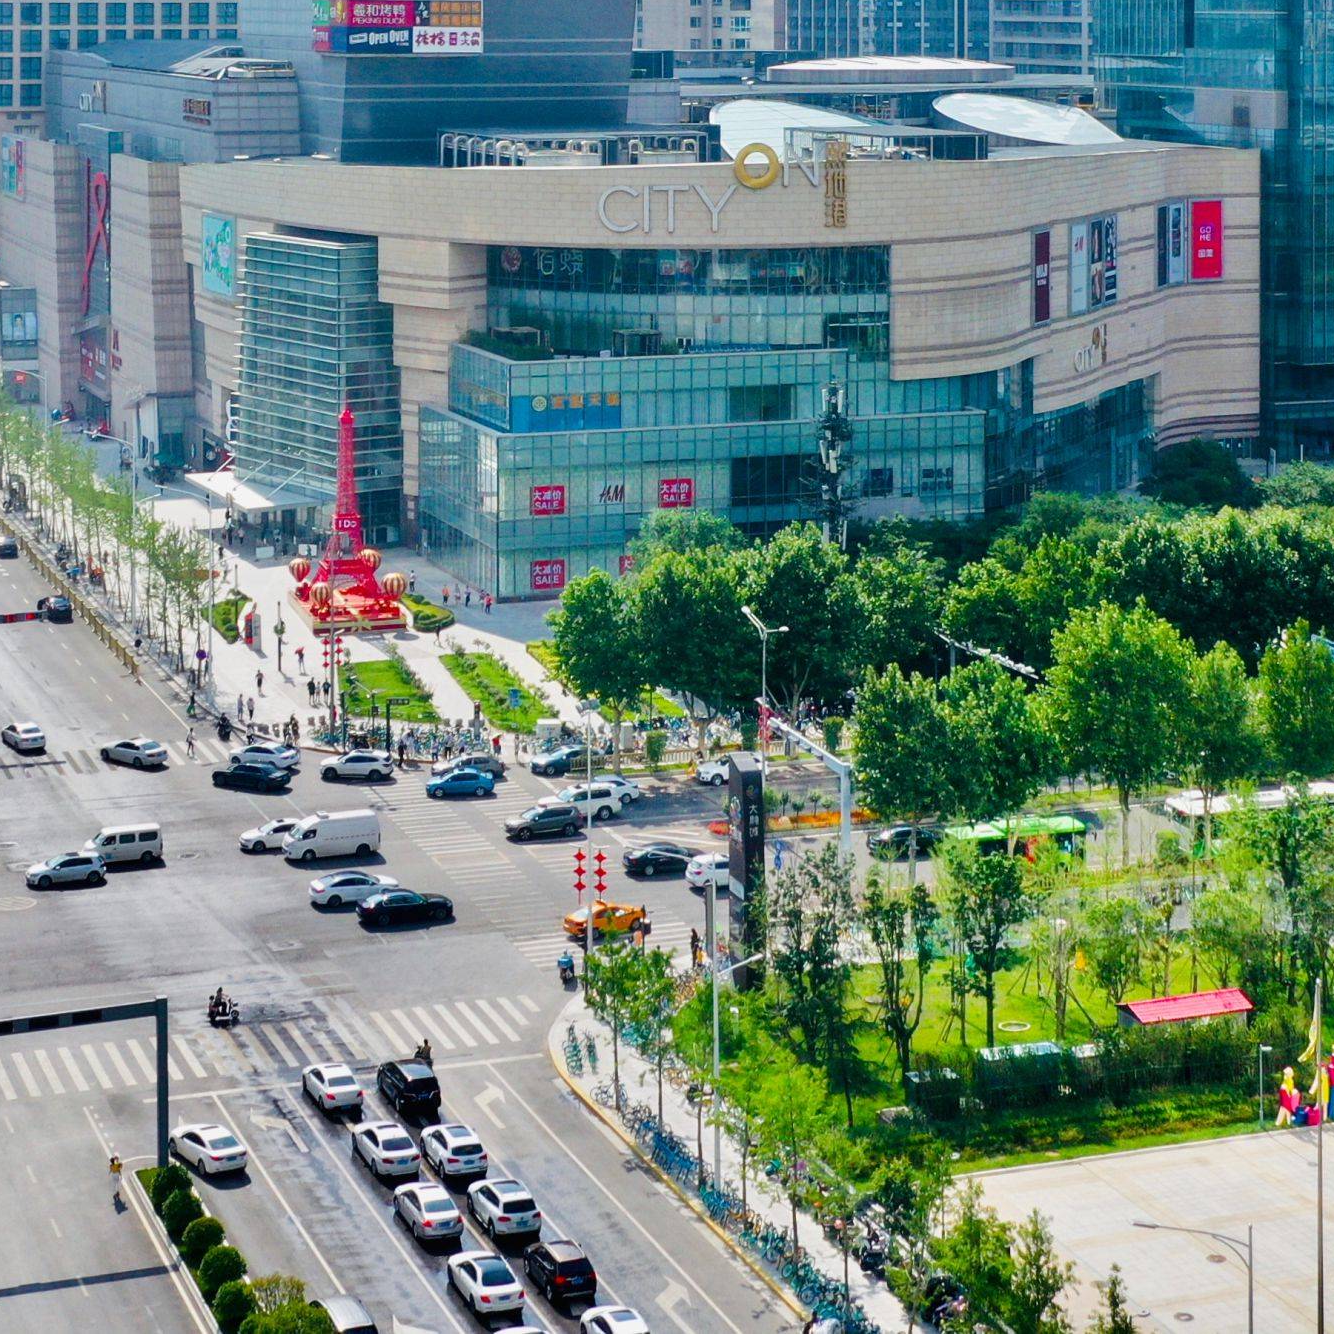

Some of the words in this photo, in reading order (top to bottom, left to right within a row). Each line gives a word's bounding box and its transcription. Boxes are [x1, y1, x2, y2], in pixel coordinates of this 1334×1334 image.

[369, 32, 388, 45] OPEN
[390, 30, 409, 43] OVEN
[597, 183, 736, 233] CITY
[733, 141, 821, 189] ON
[660, 483, 689, 493] 大减价
[533, 489, 562, 500] 大减价
[599, 485, 624, 503] H&M
[663, 493, 687, 502] SALE
[534, 500, 559, 510] SALE
[533, 564, 562, 575] 大减价
[535, 575, 559, 585] SALE
